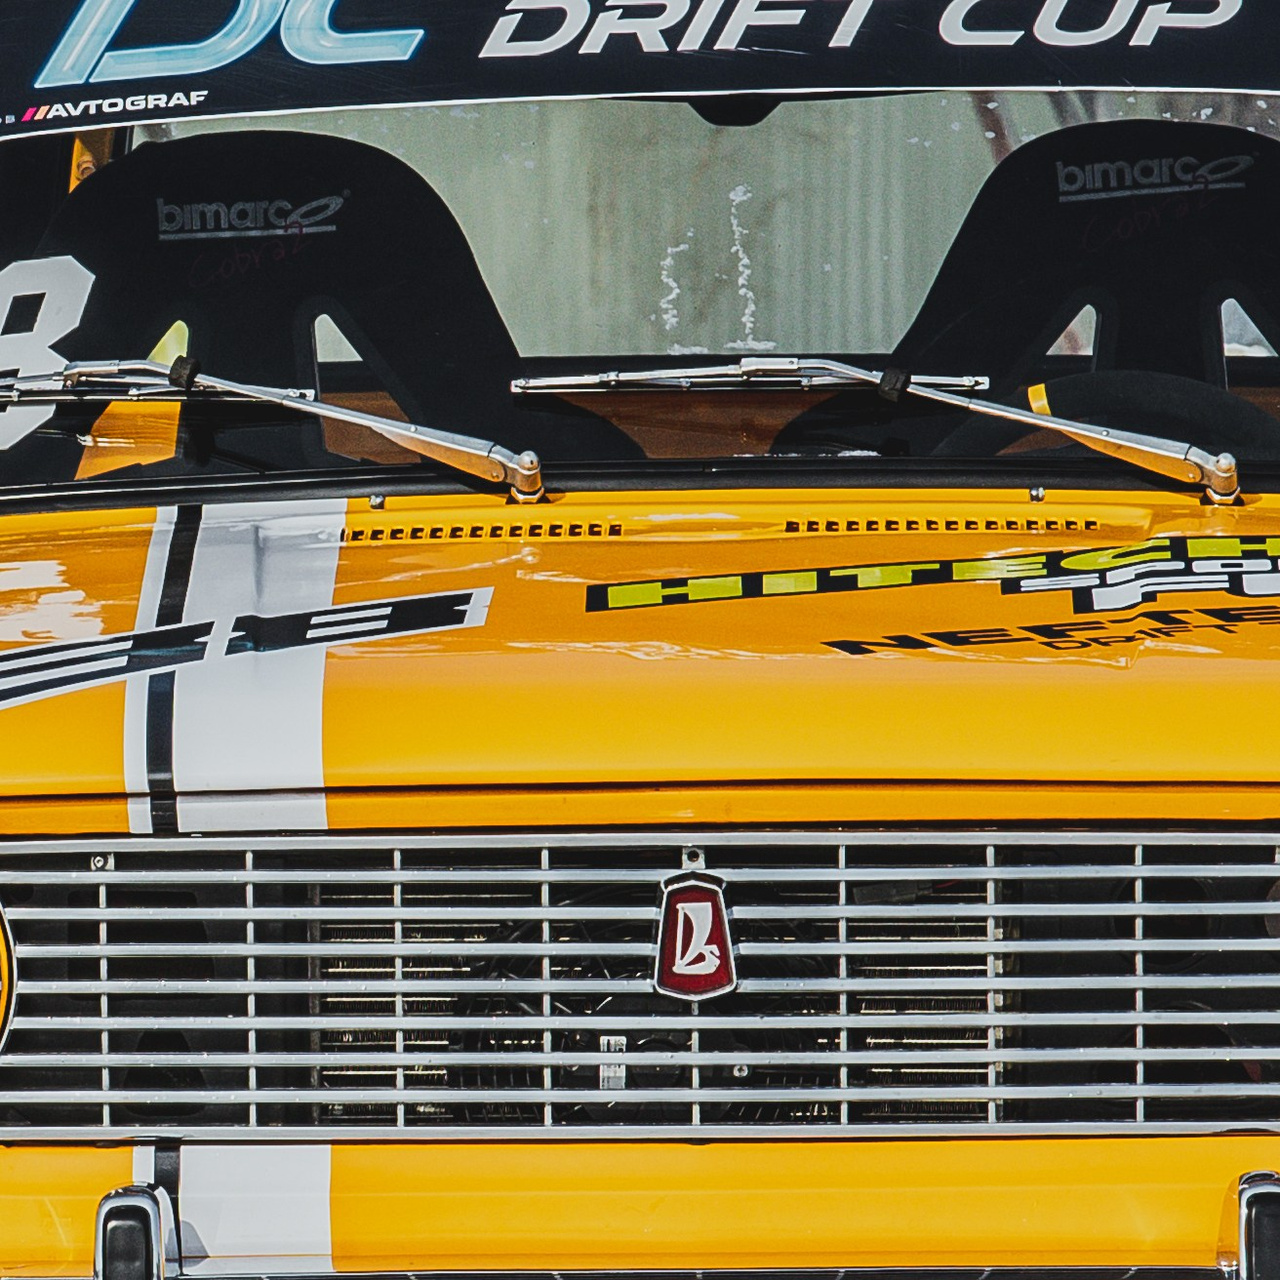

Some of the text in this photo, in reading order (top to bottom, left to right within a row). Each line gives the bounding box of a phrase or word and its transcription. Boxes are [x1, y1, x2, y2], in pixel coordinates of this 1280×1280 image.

[1055, 153, 1255, 194] bimarco
[155, 194, 345, 232] bimarco
[1019, 558, 1280, 592] SPO
[1037, 623, 1239, 651] DRIFT
